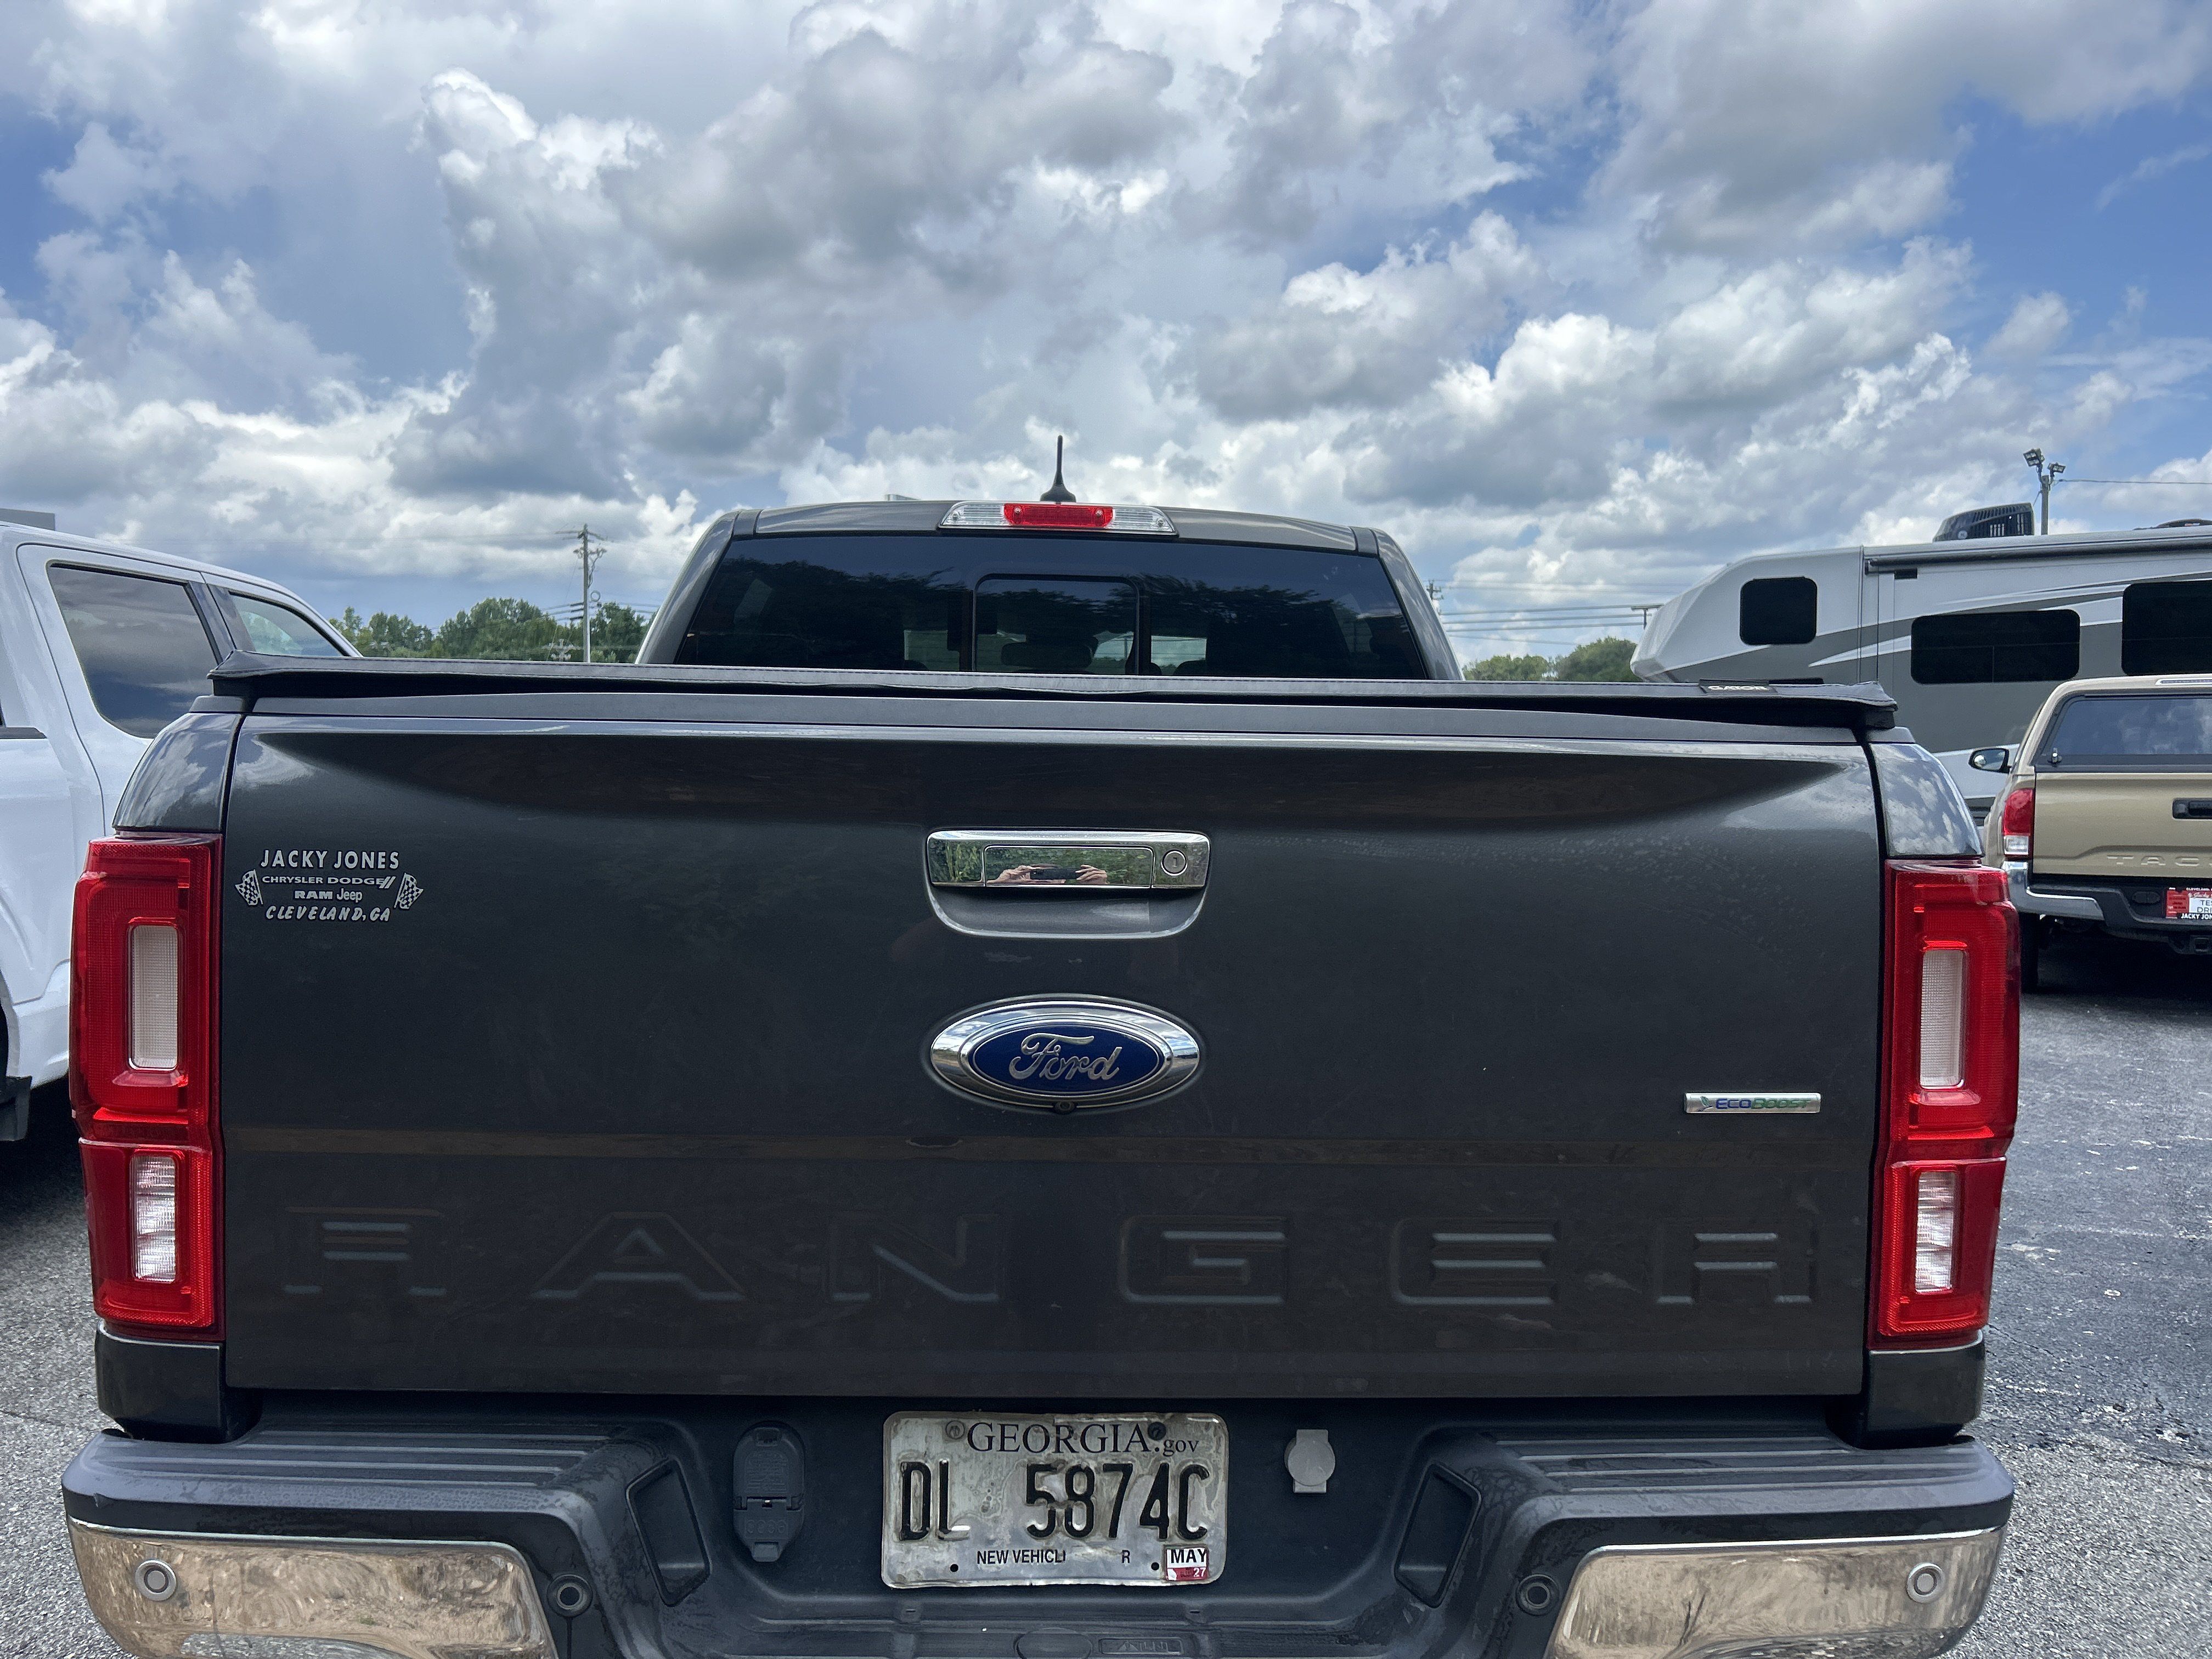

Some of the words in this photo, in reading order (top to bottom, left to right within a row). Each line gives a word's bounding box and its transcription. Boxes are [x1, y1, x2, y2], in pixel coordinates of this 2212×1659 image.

[261, 850, 328, 868] JACKY
[334, 851, 399, 869] JONES
[328, 877, 385, 885] DODGE
[295, 890, 333, 900] RAM
[336, 888, 363, 903] Jeep
[1009, 1032, 1122, 1080] Ford
[281, 1208, 1817, 1305] RANGER
[900, 1459, 970, 1541] DL
[1026, 1463, 1209, 1540] 5874C
[977, 1550, 1008, 1564] NEW
[1171, 1549, 1206, 1563] MAY
[1193, 1567, 1206, 1577] 27
